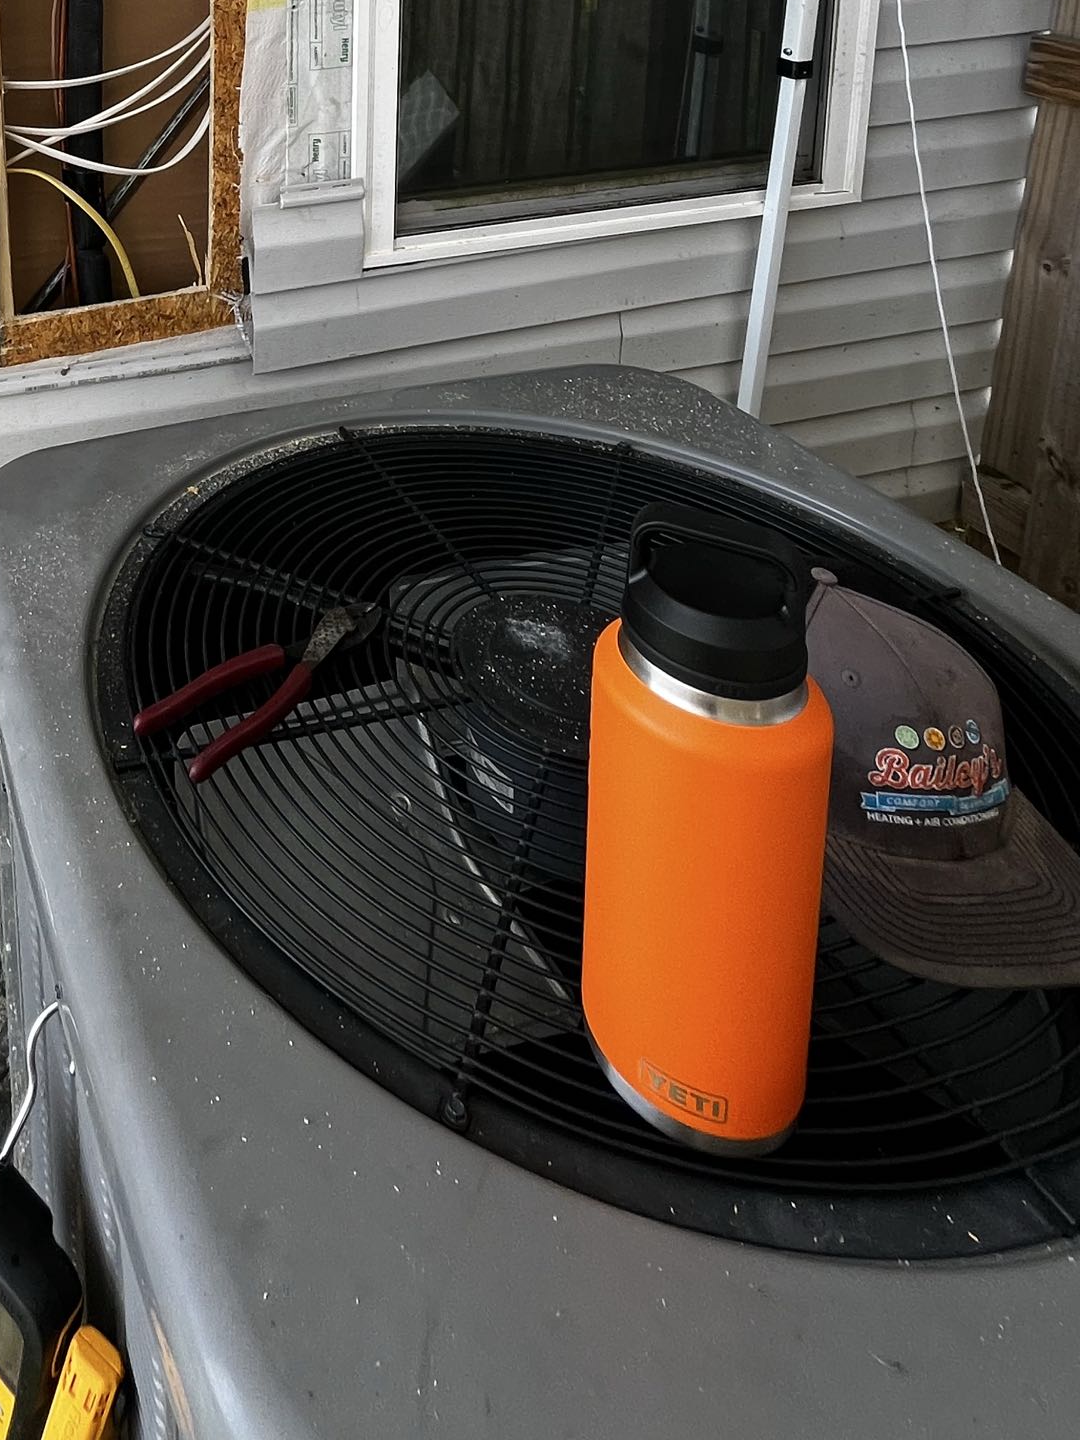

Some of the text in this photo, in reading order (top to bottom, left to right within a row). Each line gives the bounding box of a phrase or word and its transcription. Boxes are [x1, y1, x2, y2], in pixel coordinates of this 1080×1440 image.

[340, 38, 350, 62] Henry
[312, 138, 321, 162] Henry
[868, 744, 1002, 797] Bailey's
[867, 811, 914, 826] HEATING
[924, 817, 941, 827] AIR
[648, 1065, 720, 1117] YETI
